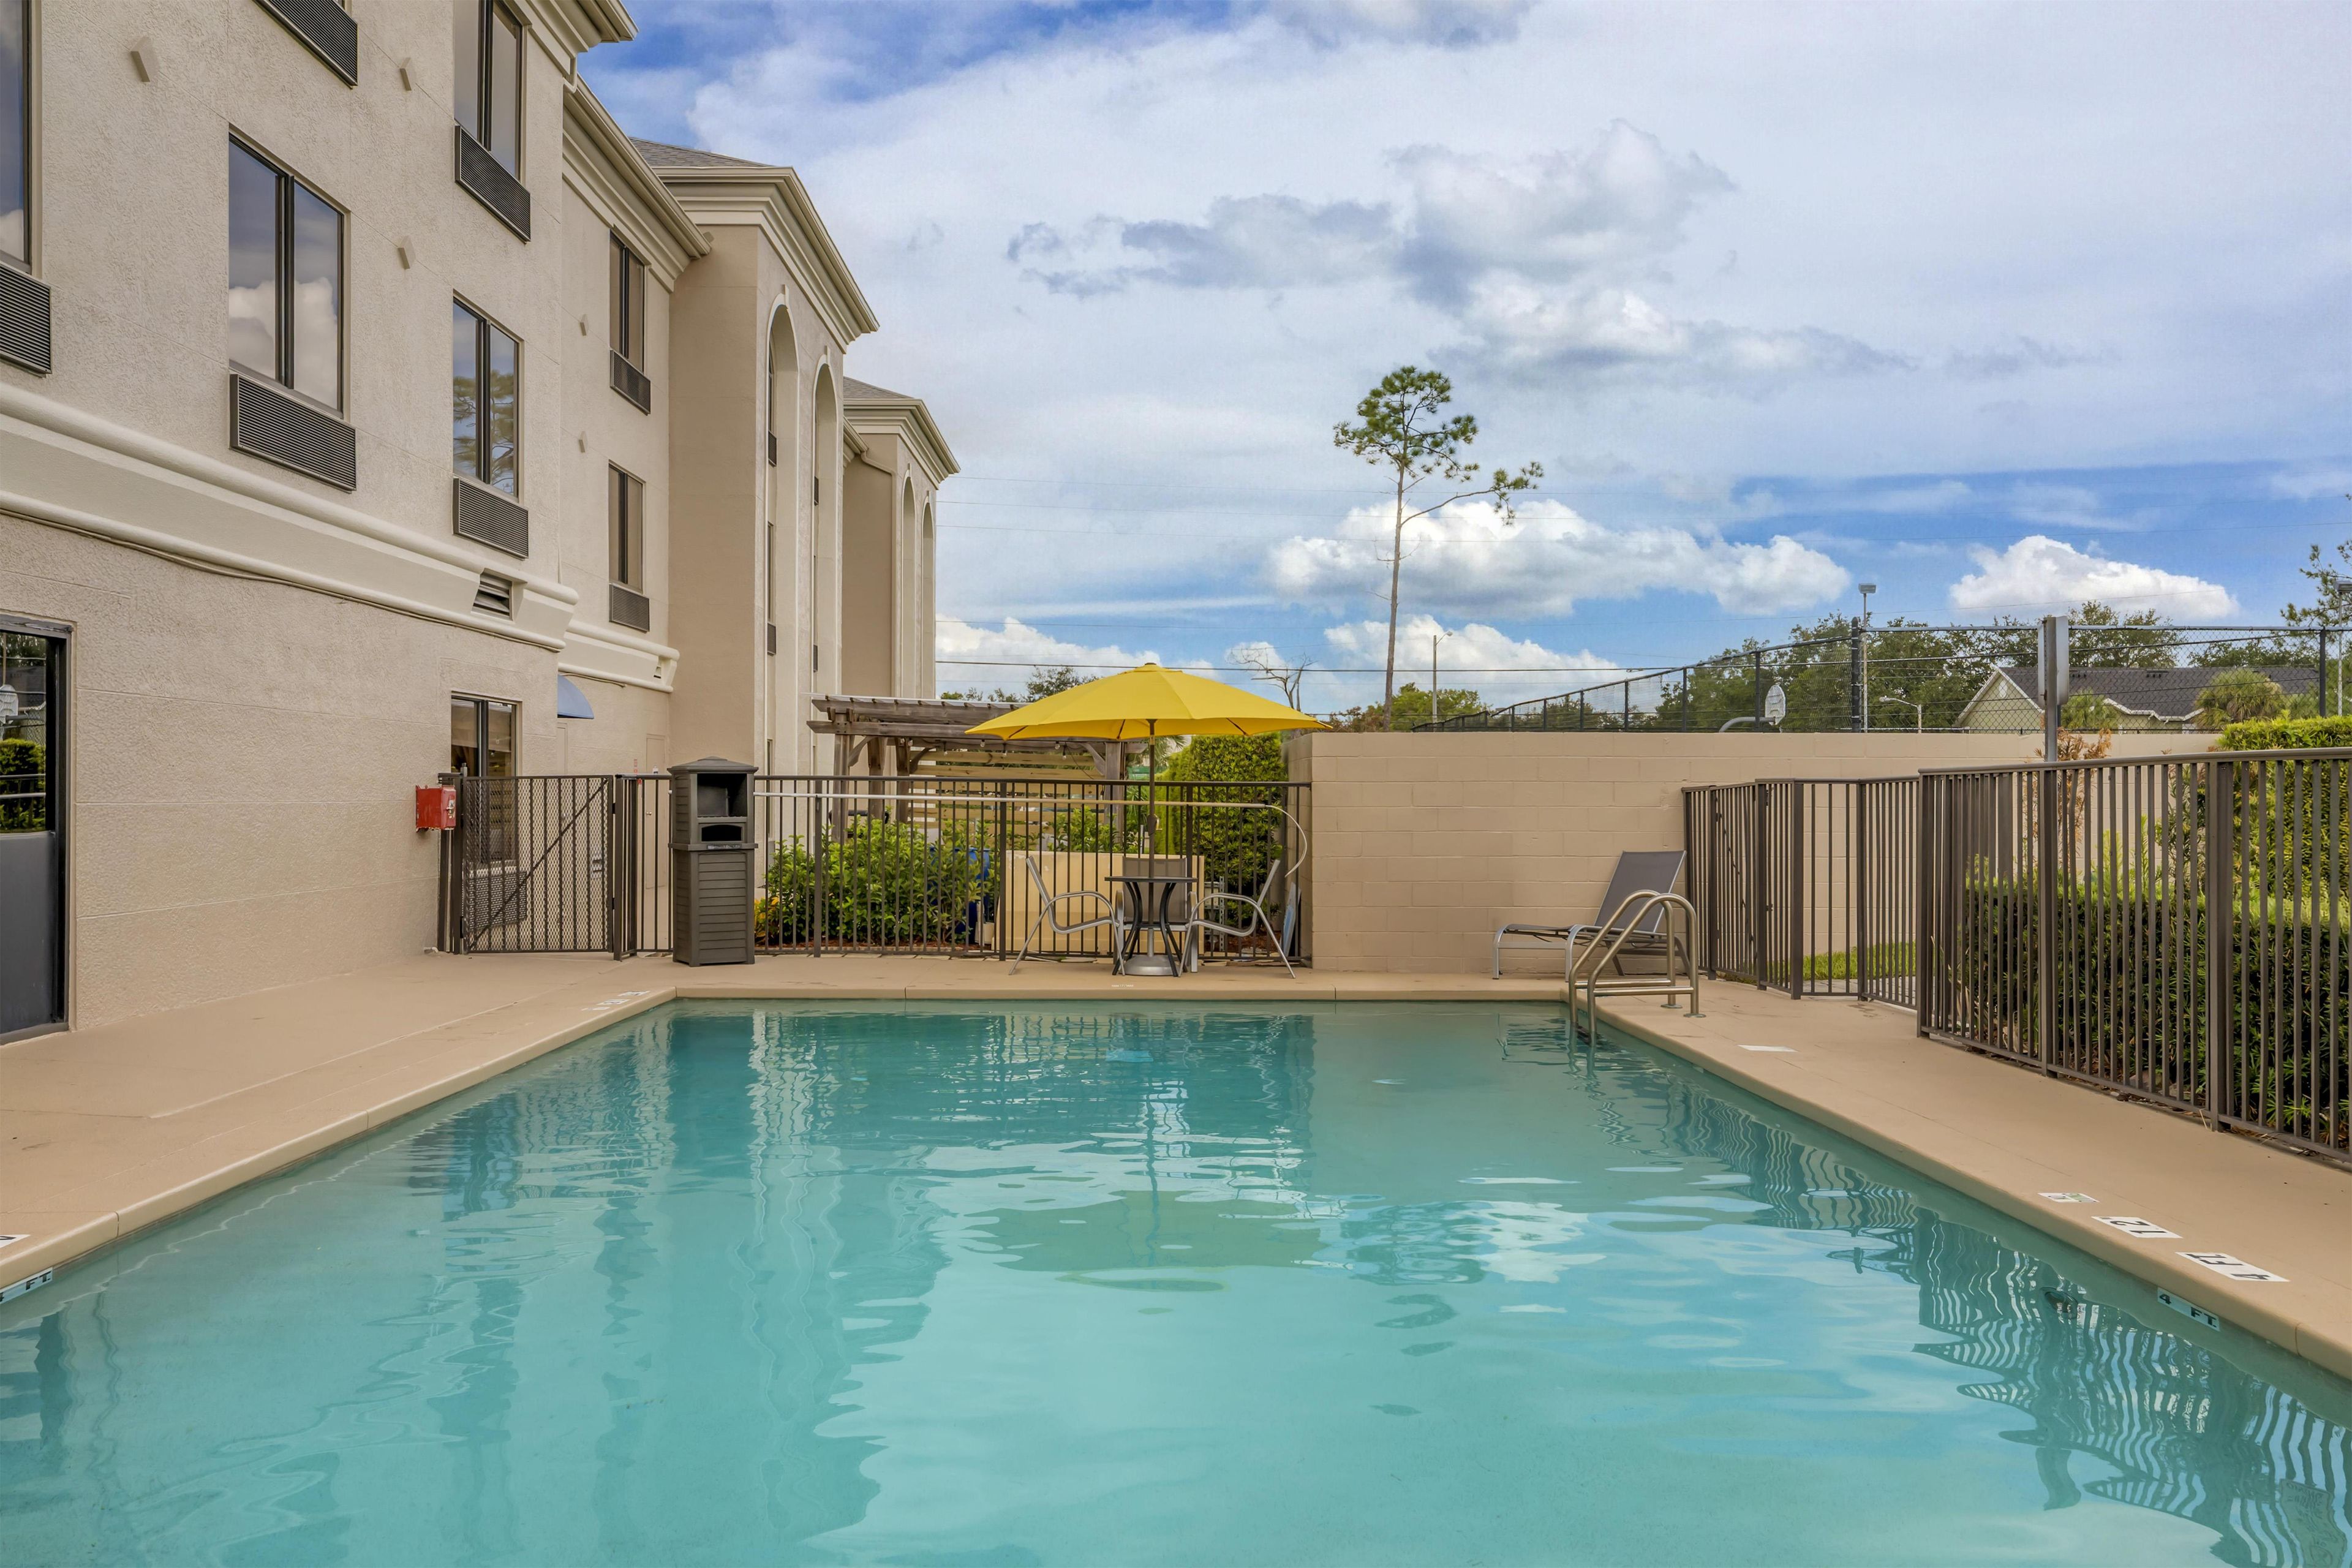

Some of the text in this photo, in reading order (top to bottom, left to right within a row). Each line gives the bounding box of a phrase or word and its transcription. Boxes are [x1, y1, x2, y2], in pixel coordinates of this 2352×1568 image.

[25, 1271, 51, 1291] FT.
[2159, 1293, 2217, 1328] 4 FT.
